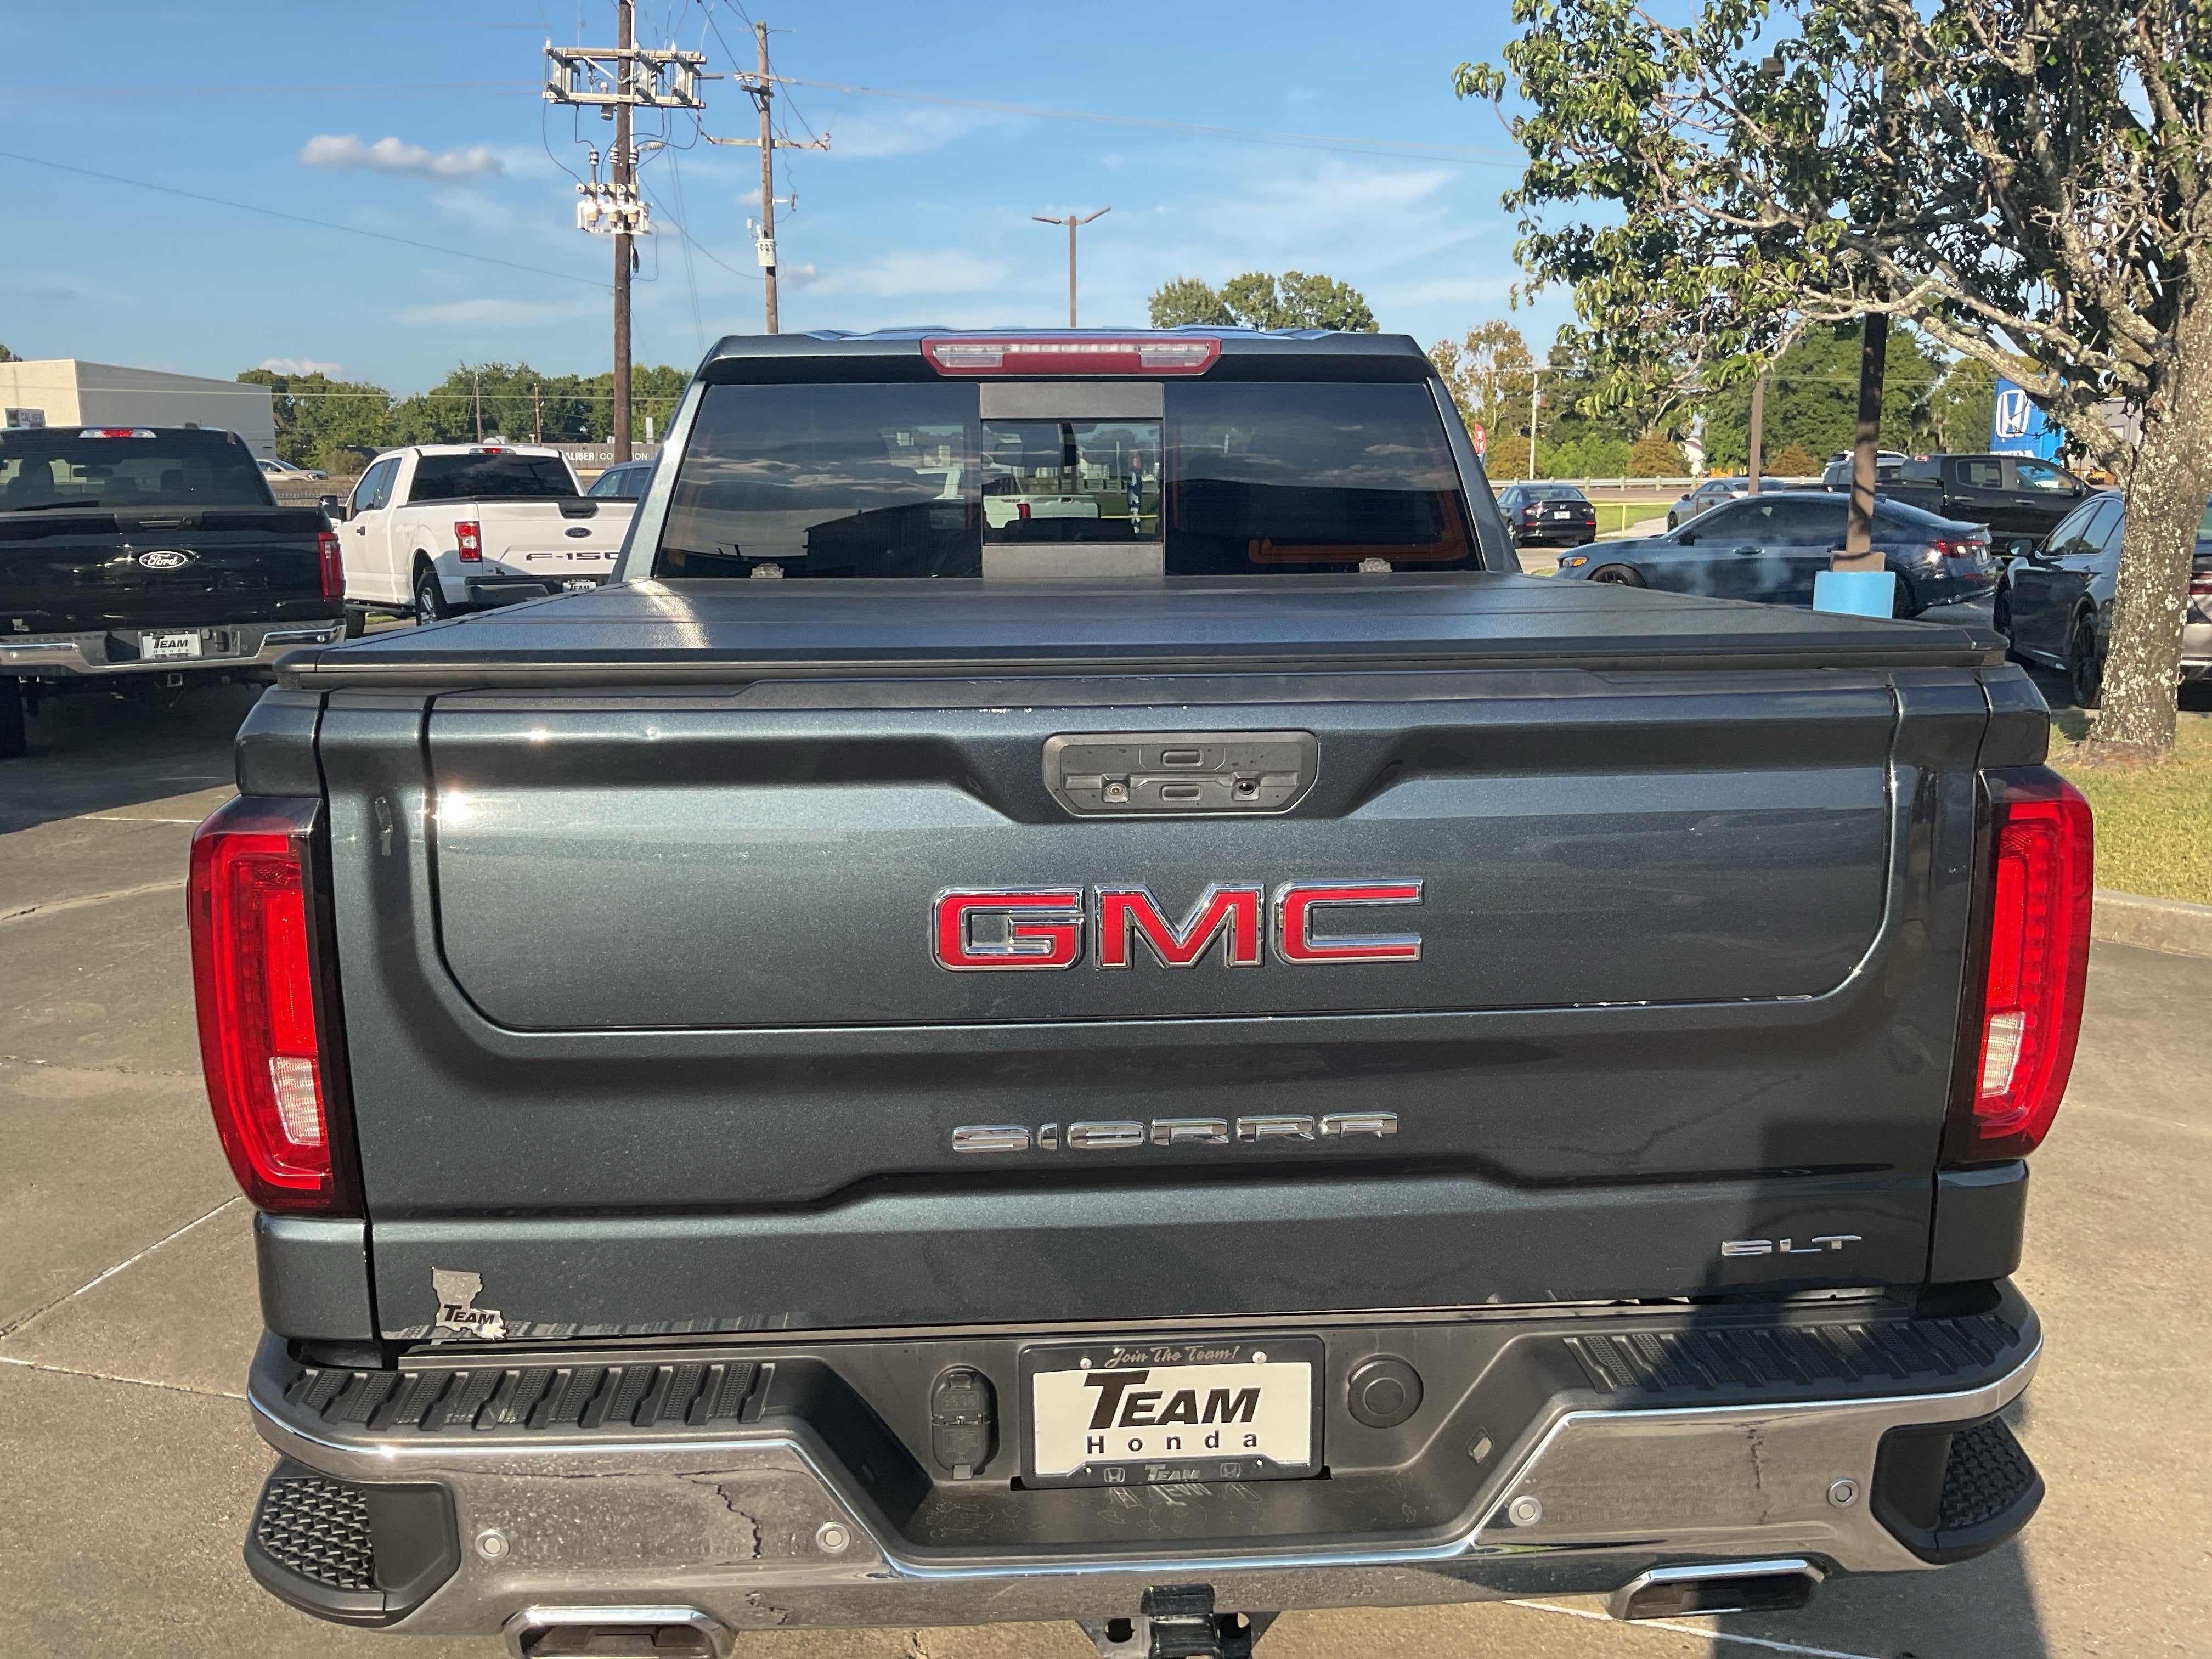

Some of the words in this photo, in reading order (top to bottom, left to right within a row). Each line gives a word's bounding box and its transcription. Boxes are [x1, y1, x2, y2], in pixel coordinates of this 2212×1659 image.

[566, 452, 595, 460] ALIBER
[147, 554, 178, 566] Ford
[152, 636, 188, 648] TEAM
[933, 879, 1424, 971] GMC
[952, 1111, 1398, 1152] SIERRA
[1721, 1235, 1861, 1256] SLT
[444, 1304, 495, 1324] TEAM
[1104, 1347, 1149, 1368] Join
[1149, 1346, 1183, 1362] The
[1184, 1345, 1240, 1362] Team!
[1083, 1369, 1261, 1430] TEAM
[1086, 1430, 1257, 1454] Honda
[1145, 1464, 1200, 1482] TEAM
